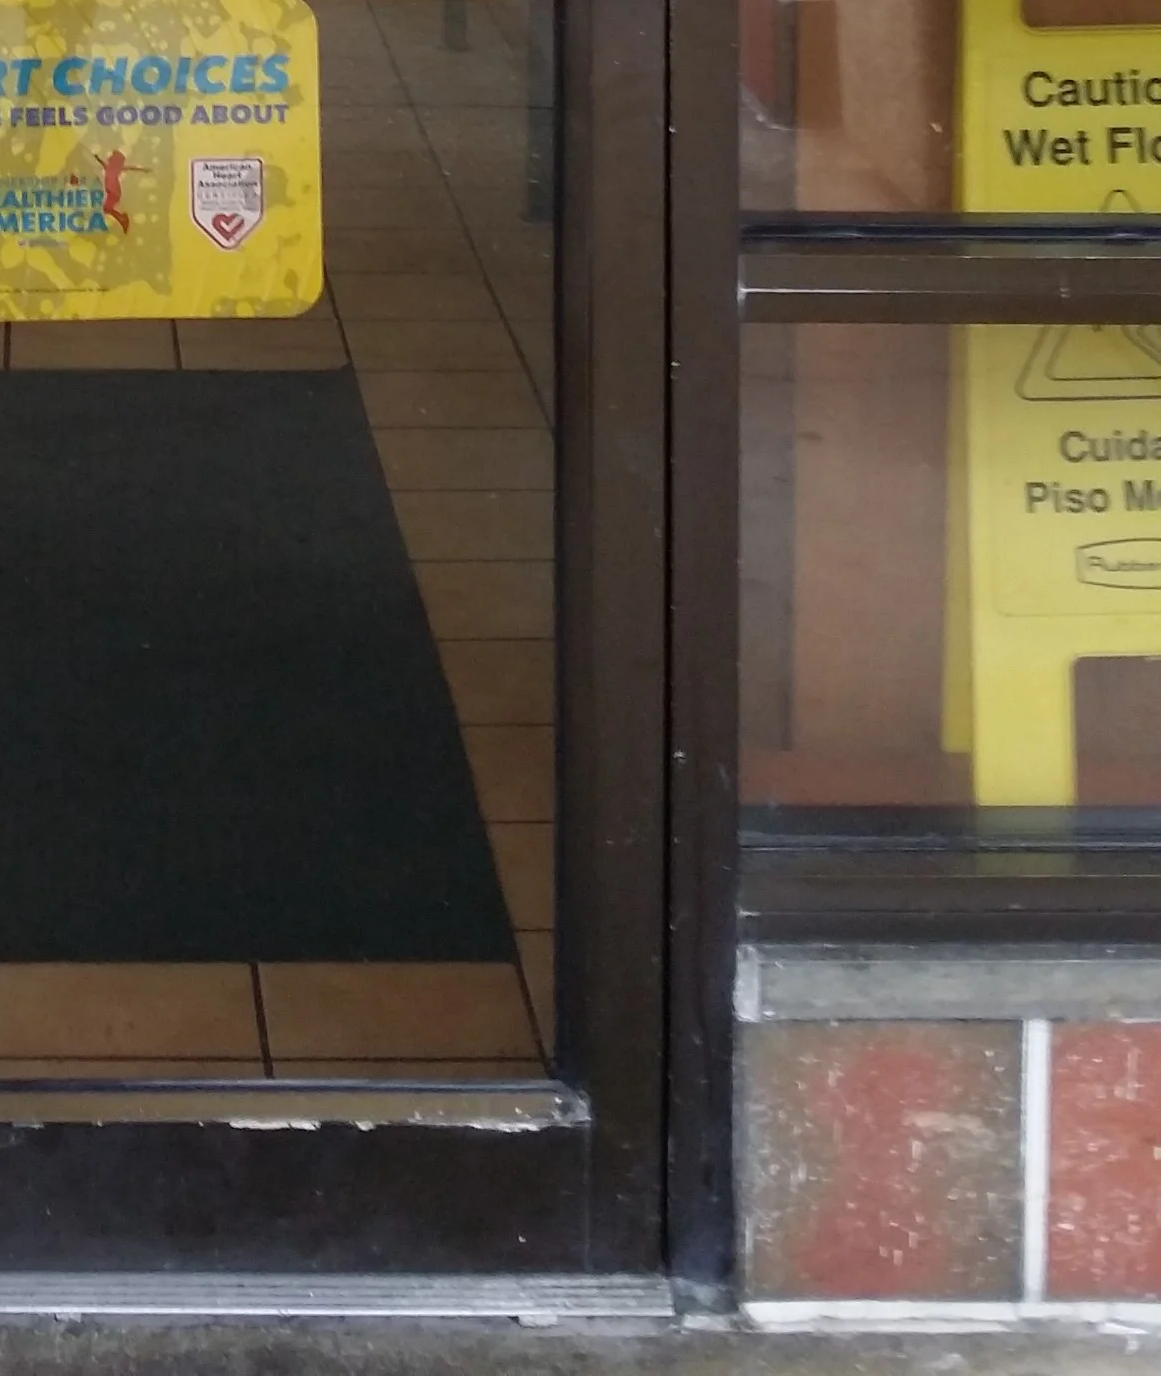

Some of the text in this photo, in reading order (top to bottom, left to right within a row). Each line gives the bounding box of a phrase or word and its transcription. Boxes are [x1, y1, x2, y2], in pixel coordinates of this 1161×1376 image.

[50, 54, 291, 97] CHOICES
[9, 106, 90, 129] FEELS
[96, 104, 183, 127] GOOD
[189, 102, 290, 126] ABOUT
[1002, 128, 1092, 167] Wet
[1024, 480, 1110, 514] Piso
